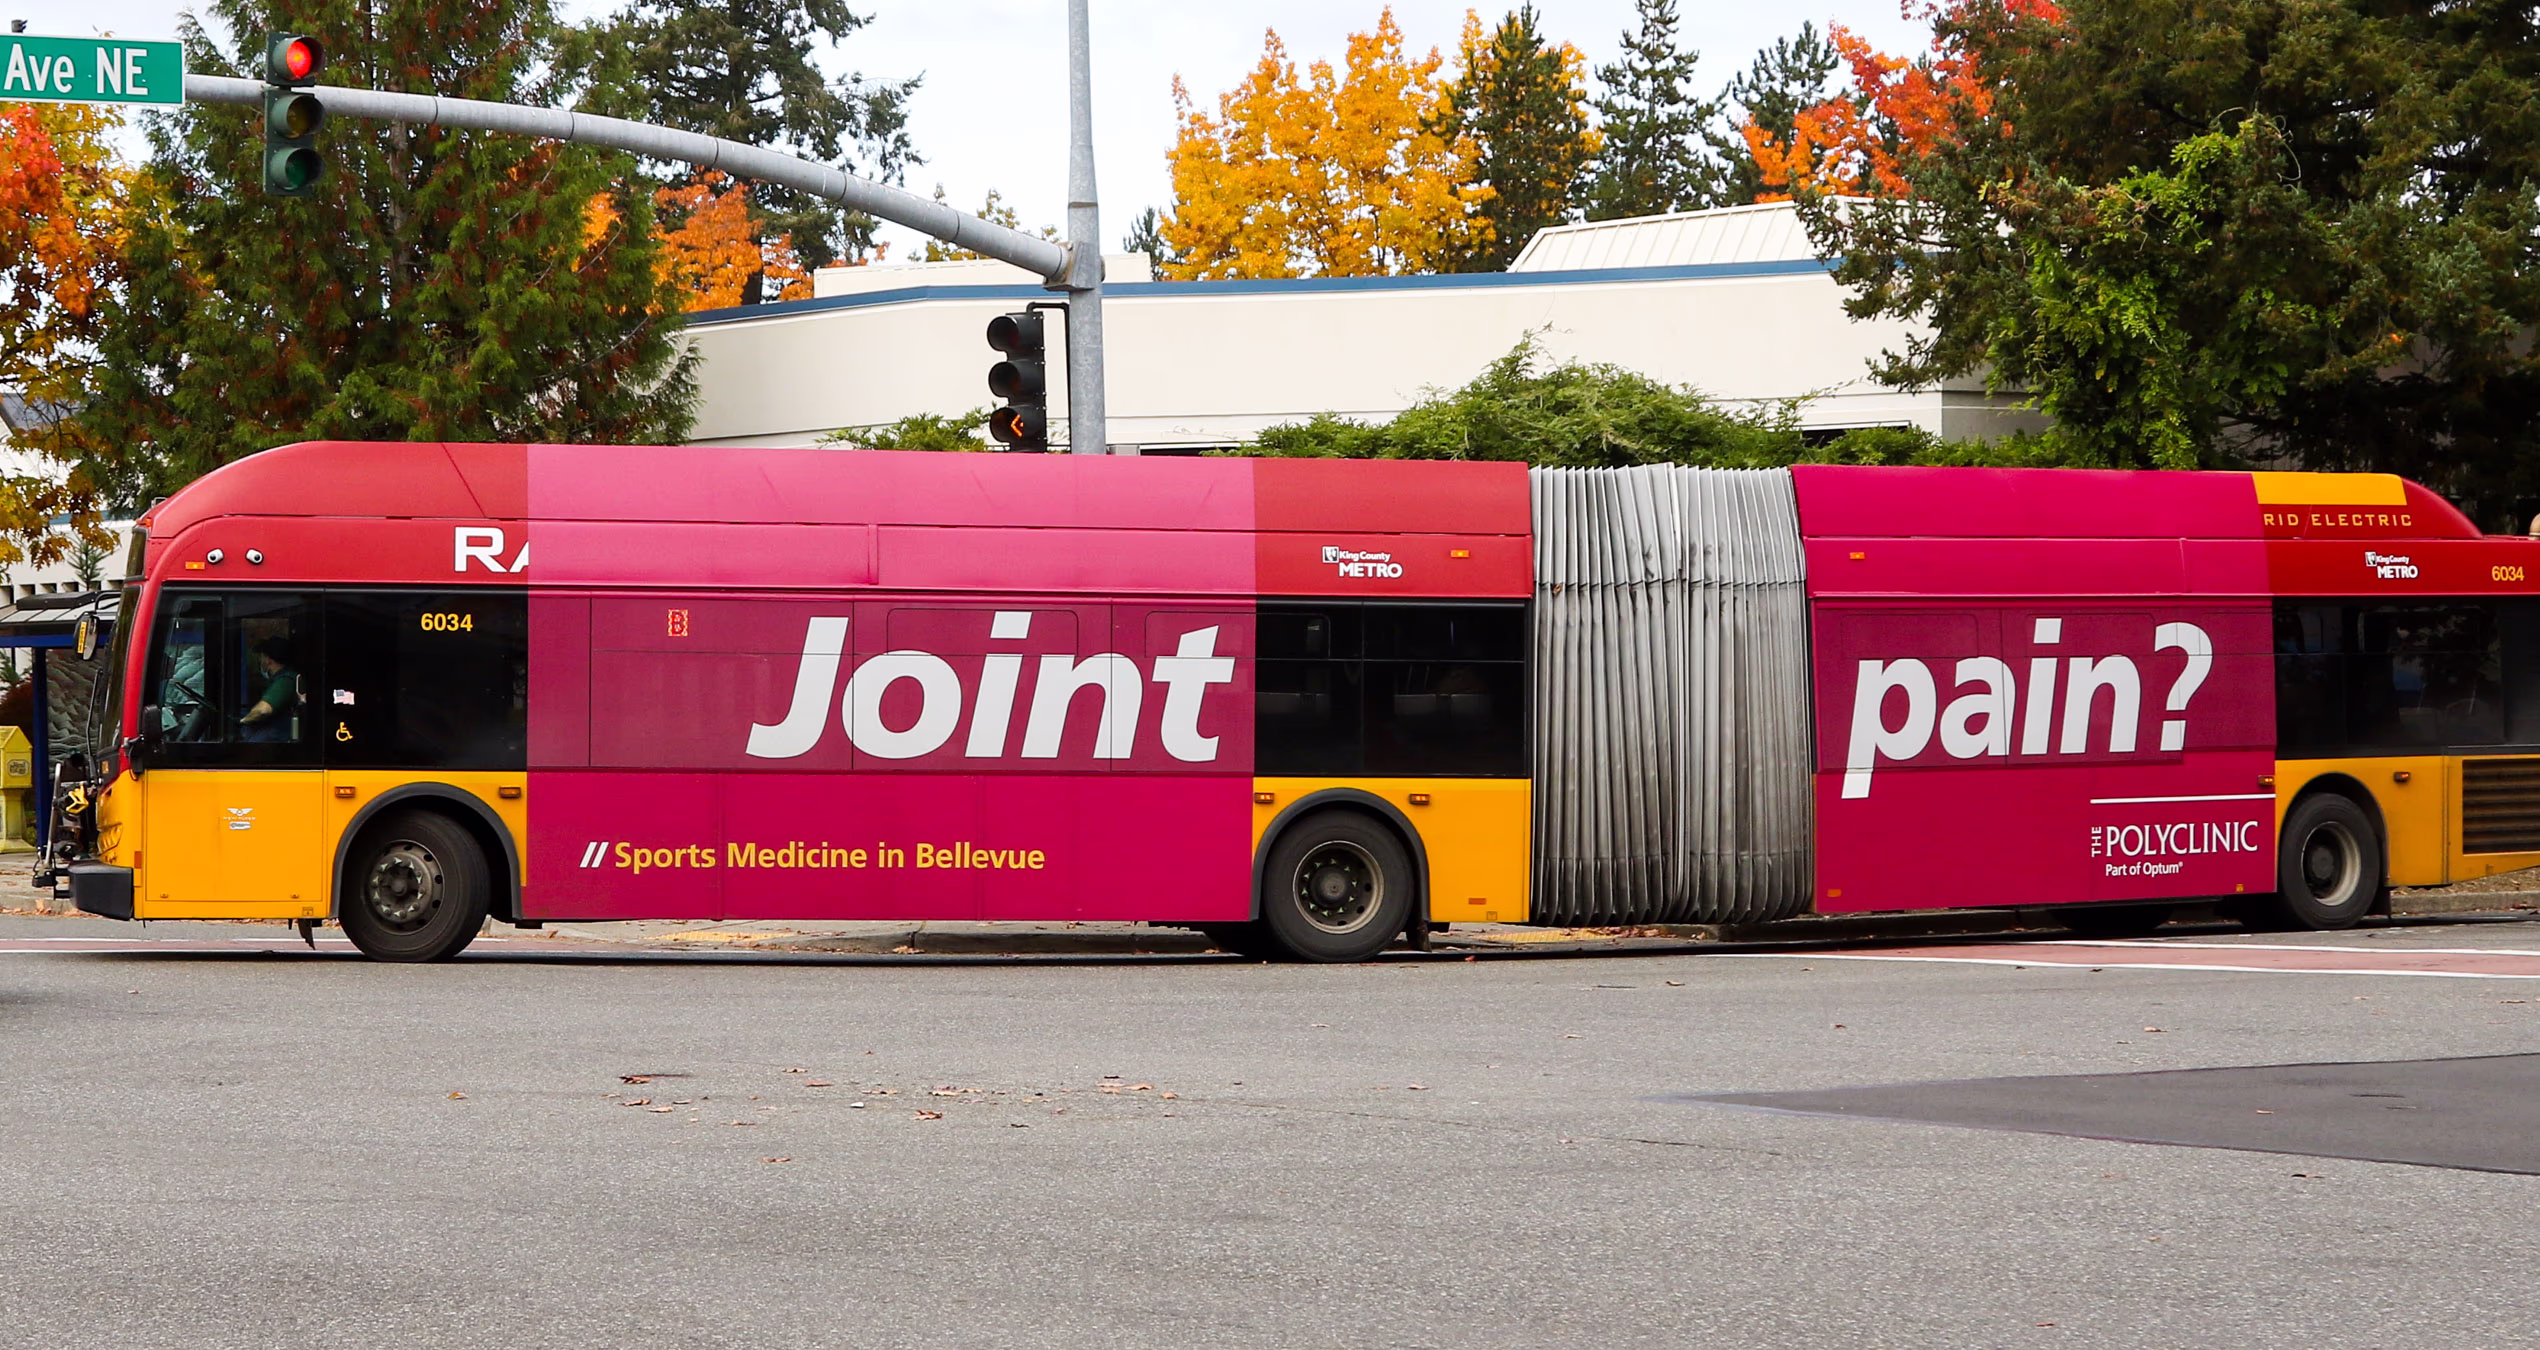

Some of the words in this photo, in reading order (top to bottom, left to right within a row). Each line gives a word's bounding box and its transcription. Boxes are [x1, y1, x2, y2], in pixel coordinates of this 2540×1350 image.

[4, 43, 75, 94] Ave
[96, 46, 149, 95] NE
[2263, 513, 2299, 526] RID
[2311, 514, 2412, 526] ELECTRIC
[1339, 550, 1360, 561] King
[1360, 551, 1391, 562] County
[2376, 555, 2389, 564] King
[2389, 555, 2409, 564] County
[1338, 562, 1403, 578] METRO
[2376, 565, 2418, 579] METRO
[2491, 566, 2525, 581] 6034
[420, 613, 473, 631] 6034
[745, 611, 1236, 762] Joint
[1841, 618, 2213, 799] pain?
[2091, 826, 2102, 857] THE
[2105, 821, 2258, 857] POLYCLINIC
[614, 841, 716, 875] Sports
[727, 841, 867, 868] Medicine
[878, 841, 904, 868] in
[916, 841, 1045, 869] Bellevue
[2105, 863, 2127, 877] Part
[2129, 862, 2141, 875] of
